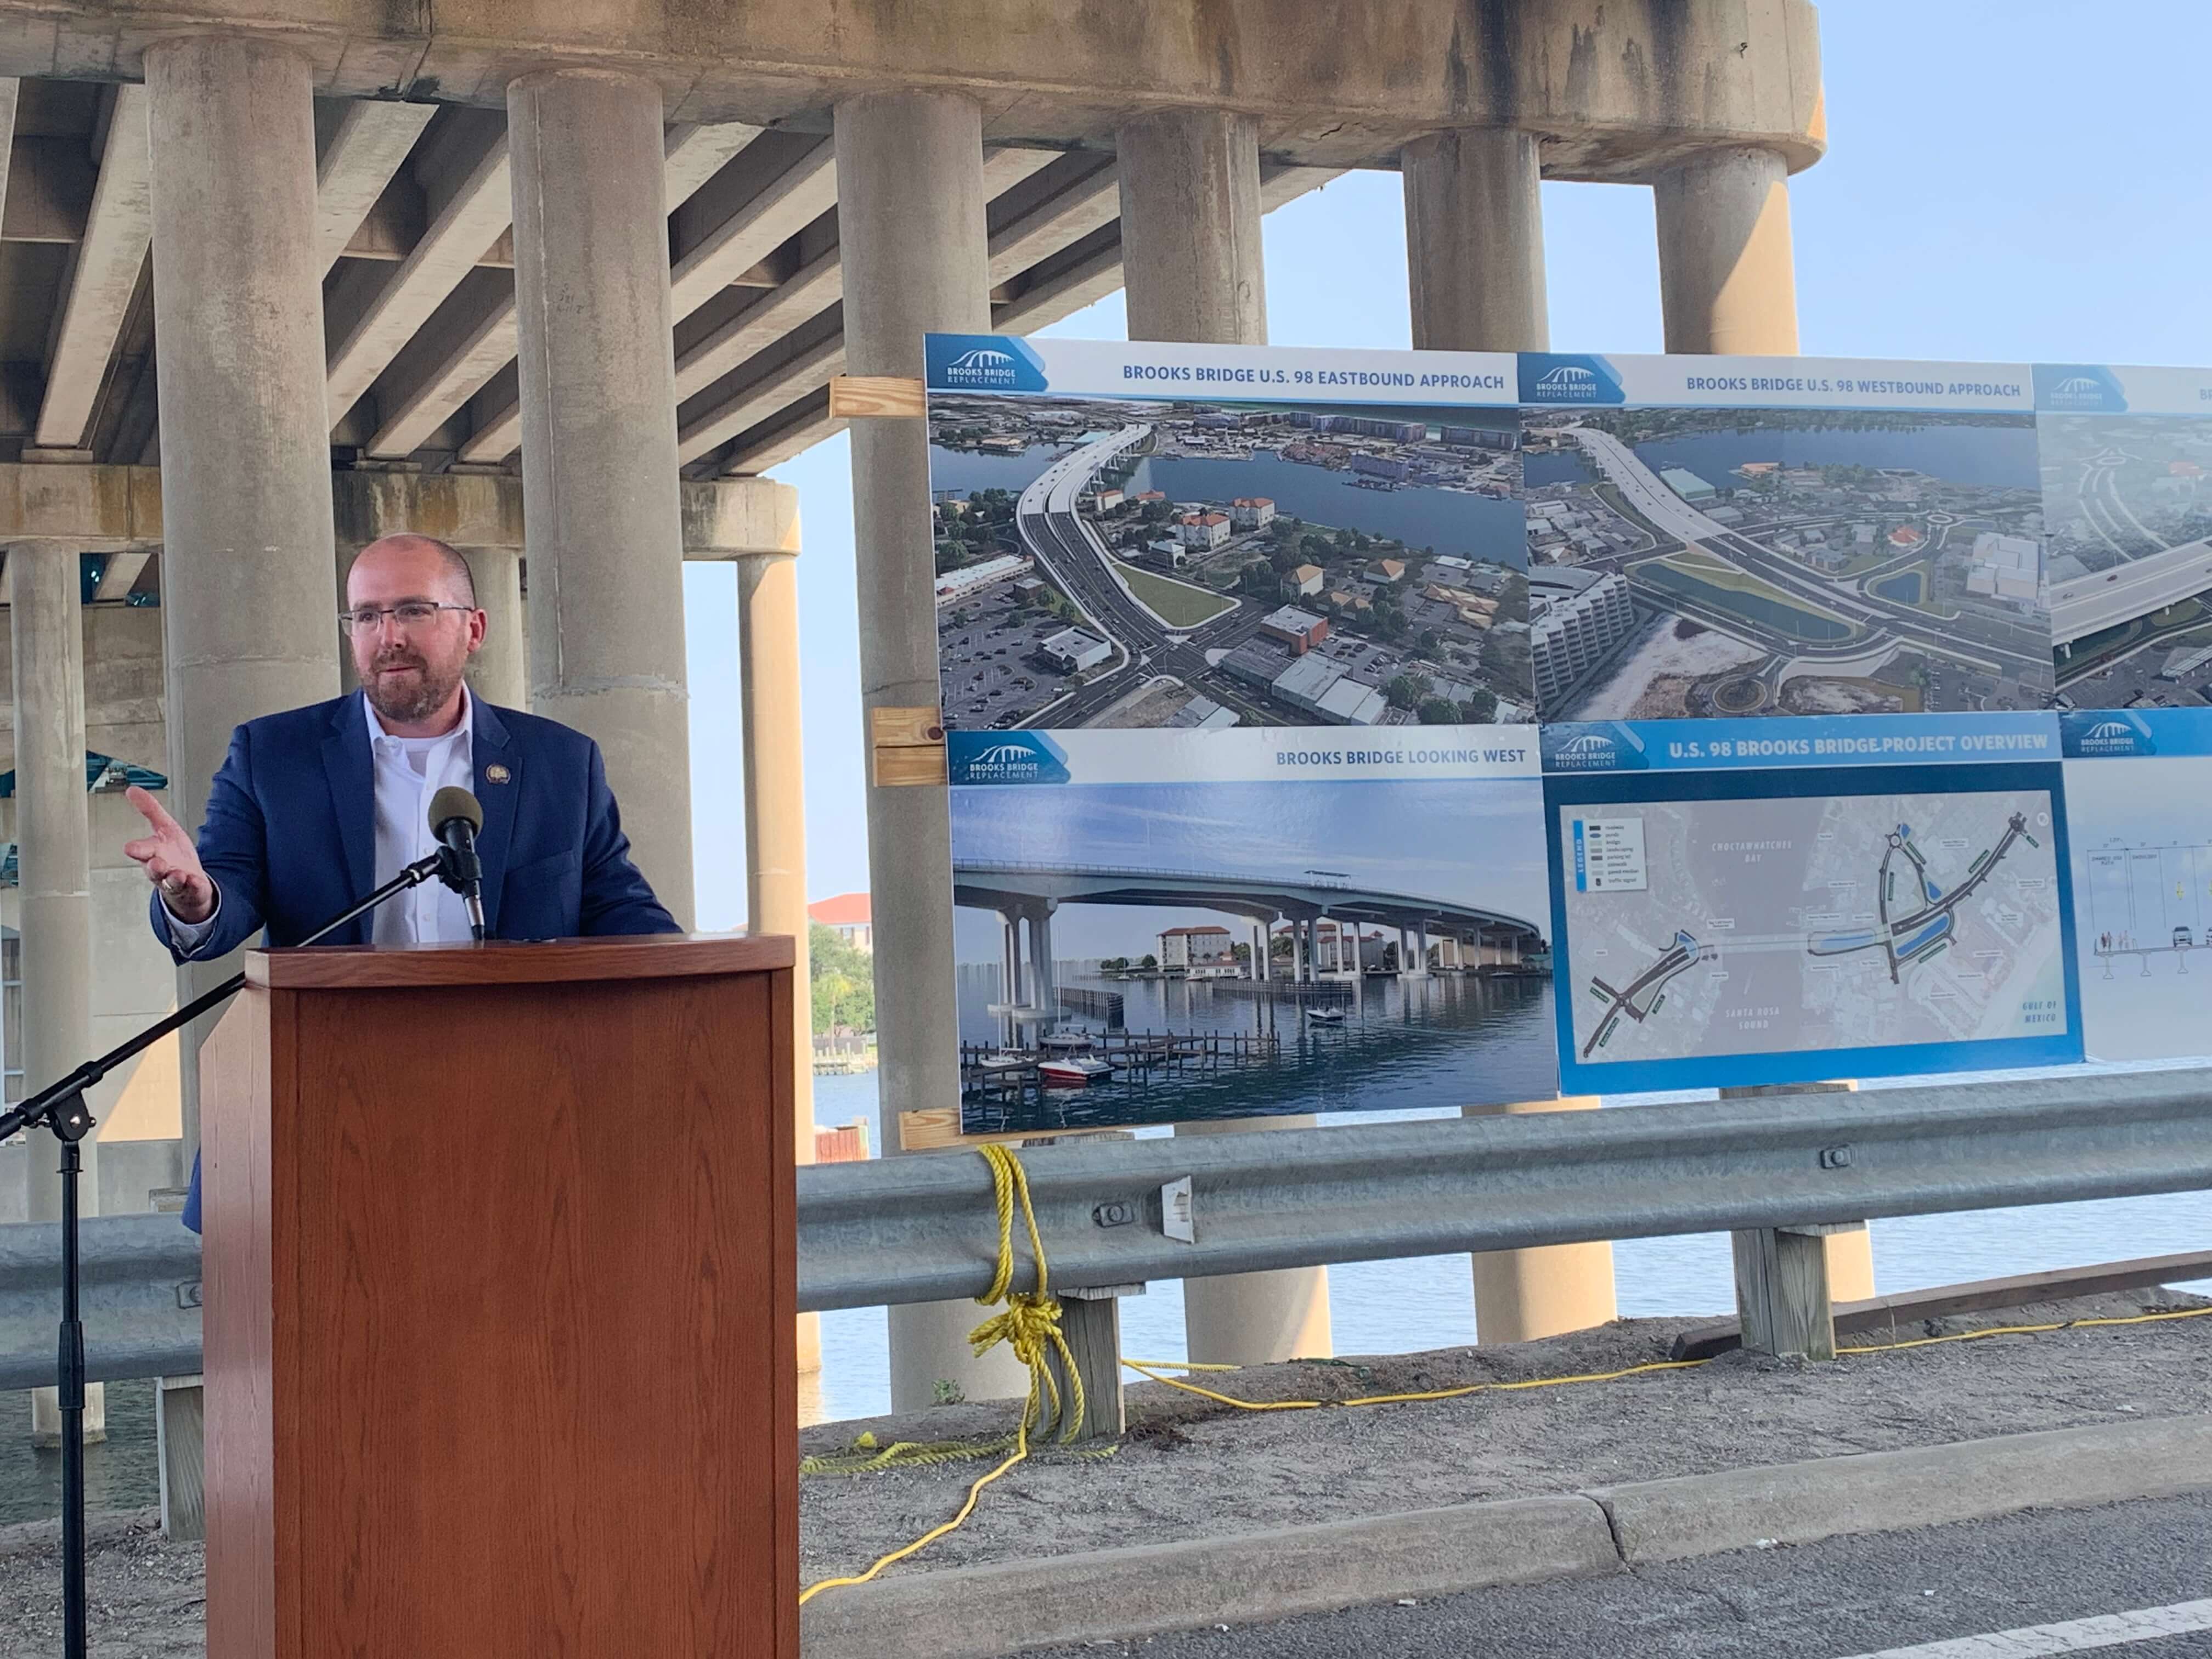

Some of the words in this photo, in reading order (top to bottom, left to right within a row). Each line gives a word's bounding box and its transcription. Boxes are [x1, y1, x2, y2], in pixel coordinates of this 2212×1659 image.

[947, 368, 982, 376] BROOKS
[985, 368, 1016, 377] BRIDGE
[1123, 365, 1190, 380] BROOKS
[1196, 368, 1255, 382] BRIDGE
[1260, 369, 1290, 383] U.S.
[1294, 370, 1313, 384] 98
[1318, 371, 1415, 386] EASTBOUND
[1420, 374, 1504, 389] APPROACH
[947, 376, 1016, 385] REPLACEMENT
[1686, 377, 1747, 390] BROOKS
[1751, 378, 1803, 391] BRIDGE
[1807, 379, 1833, 392] U.S.
[1836, 380, 1853, 392] 98
[1858, 381, 1944, 394] WESTBOUND
[1949, 383, 2021, 396] APPROACH
[1669, 742, 1705, 758] U.S.
[1709, 742, 1732, 757] 98
[1736, 740, 1809, 757] BROOKS
[1814, 738, 1878, 754] BRIDGE
[1883, 736, 1955, 752] PROJECT
[1960, 734, 2048, 751] OVERVIEW
[1277, 752, 1342, 765] BROOKS
[1346, 751, 1404, 764] BRIDGE
[1408, 750, 1479, 764] LOOKING
[1483, 749, 1526, 763] WEST
[1555, 752, 1586, 760] BROOKS
[1588, 752, 1616, 760] BRIDGE
[969, 763, 1004, 771] BROOKS
[1007, 763, 1039, 771] BRIDGE
[969, 771, 1039, 779] REPLACEMENT
[1745, 854, 1763, 863] BAY
[2023, 1001, 2044, 1011] GULF
[2047, 1000, 2056, 1009] OF
[1725, 1008, 1753, 1018] SANTA
[1757, 1007, 1780, 1017] ROSA
[2024, 1013, 2056, 1023] MEXICO
[1738, 1019, 1769, 1030] SOUND
